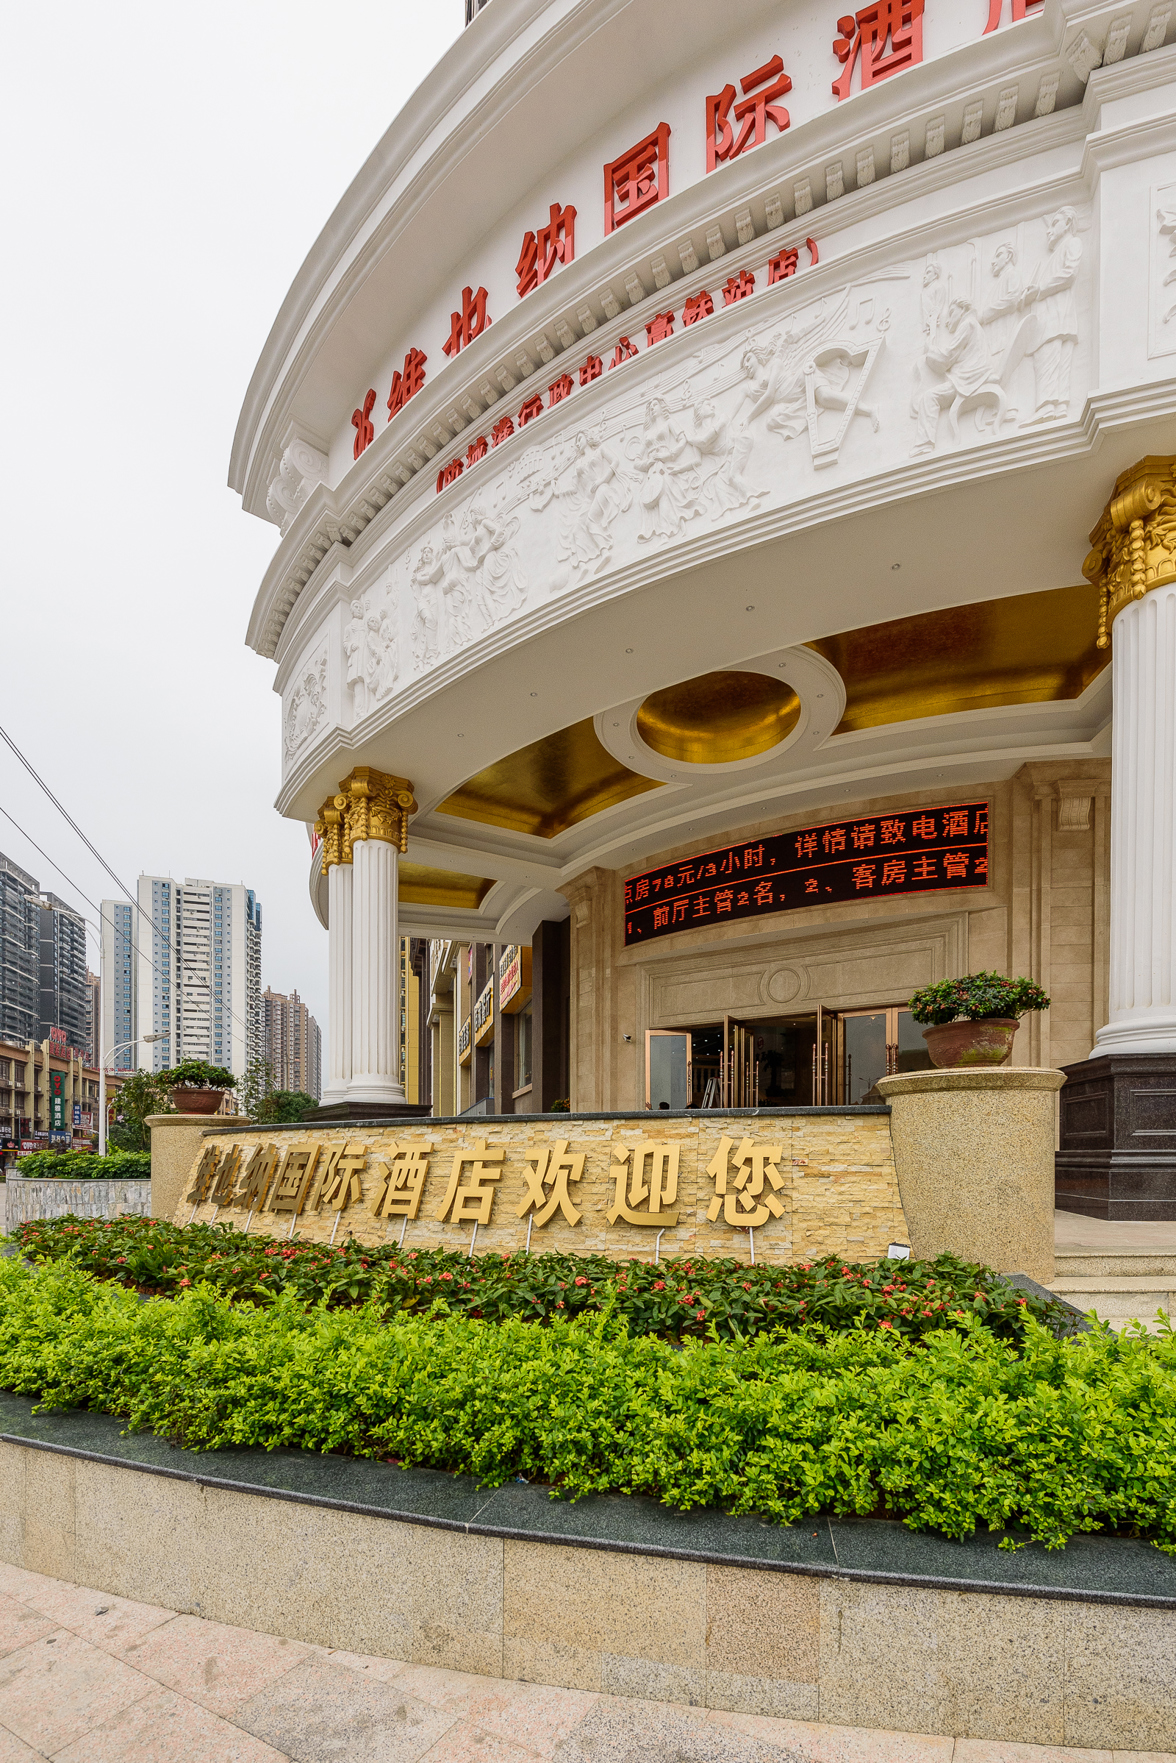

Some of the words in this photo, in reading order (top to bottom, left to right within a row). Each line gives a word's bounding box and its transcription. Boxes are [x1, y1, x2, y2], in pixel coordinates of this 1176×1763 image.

[53, 1075, 62, 1096] OYO
[186, 1136, 787, 1228] 维也纳国际酒店欢迎您
